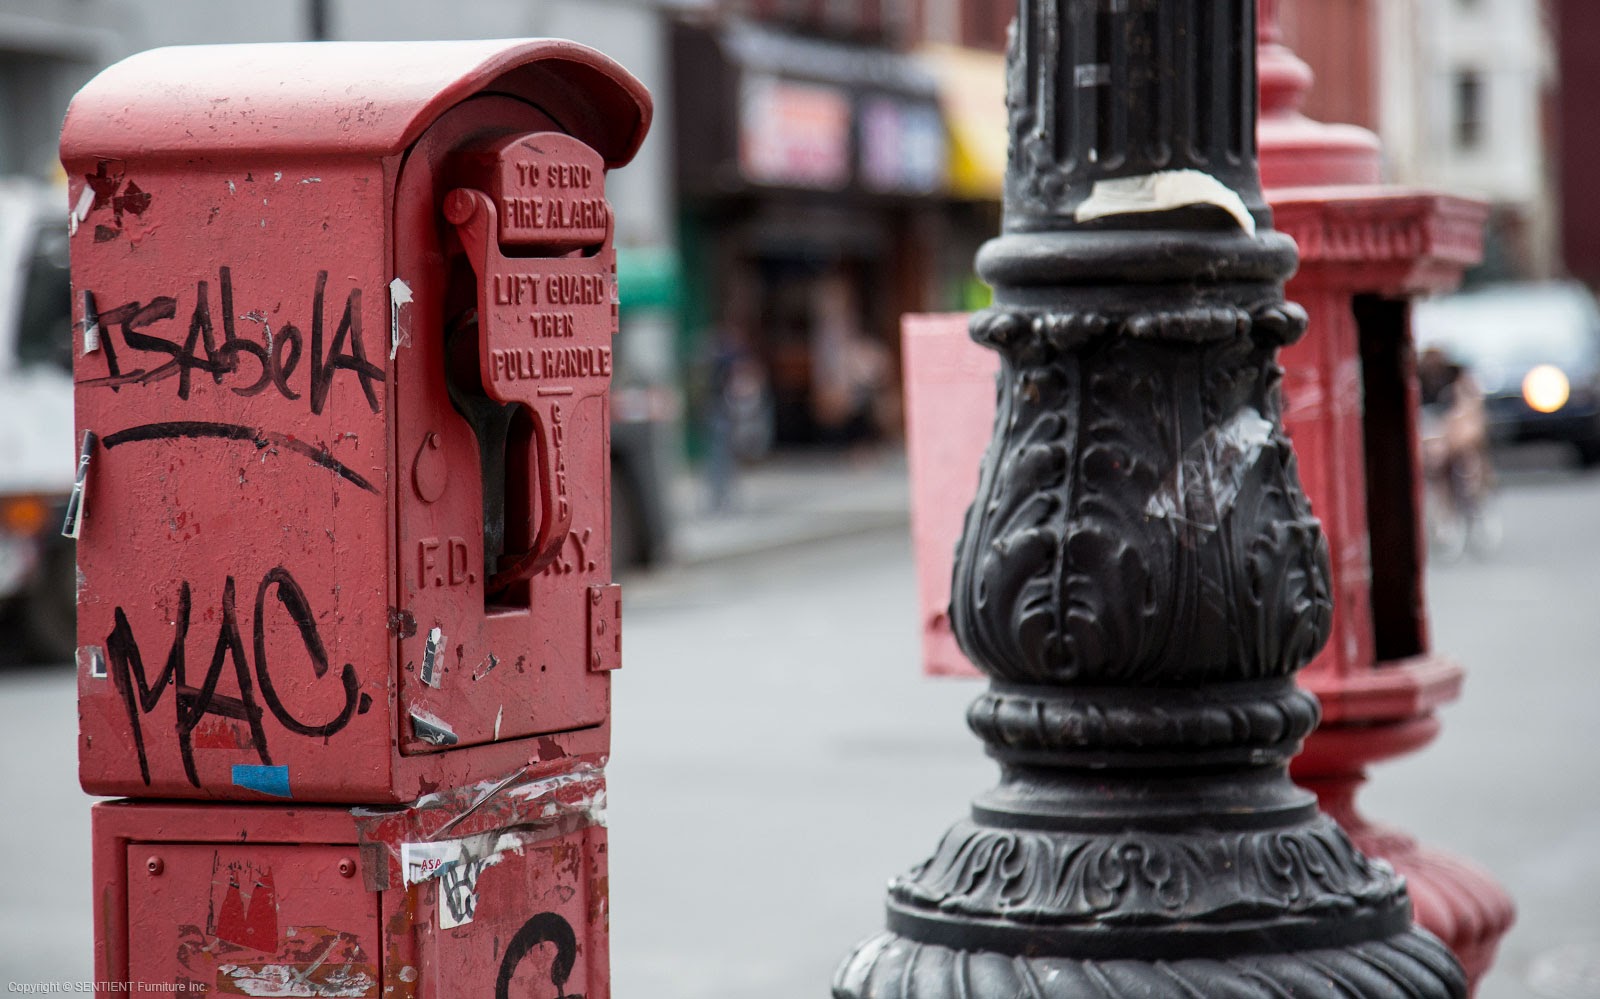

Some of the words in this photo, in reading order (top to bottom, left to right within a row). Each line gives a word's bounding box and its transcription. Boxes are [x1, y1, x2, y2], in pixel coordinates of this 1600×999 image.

[516, 161, 540, 187] TO
[547, 161, 592, 189] SEND
[503, 196, 544, 229] FIRE
[546, 197, 607, 229] ALARM
[494, 273, 540, 306] LIFT
[546, 273, 604, 305] GUARD
[529, 312, 574, 338] THEN
[492, 347, 541, 381] PULL
[541, 345, 611, 379] HANDLE
[551, 400, 569, 523] GUARD
[418, 536, 476, 589] F.D.
